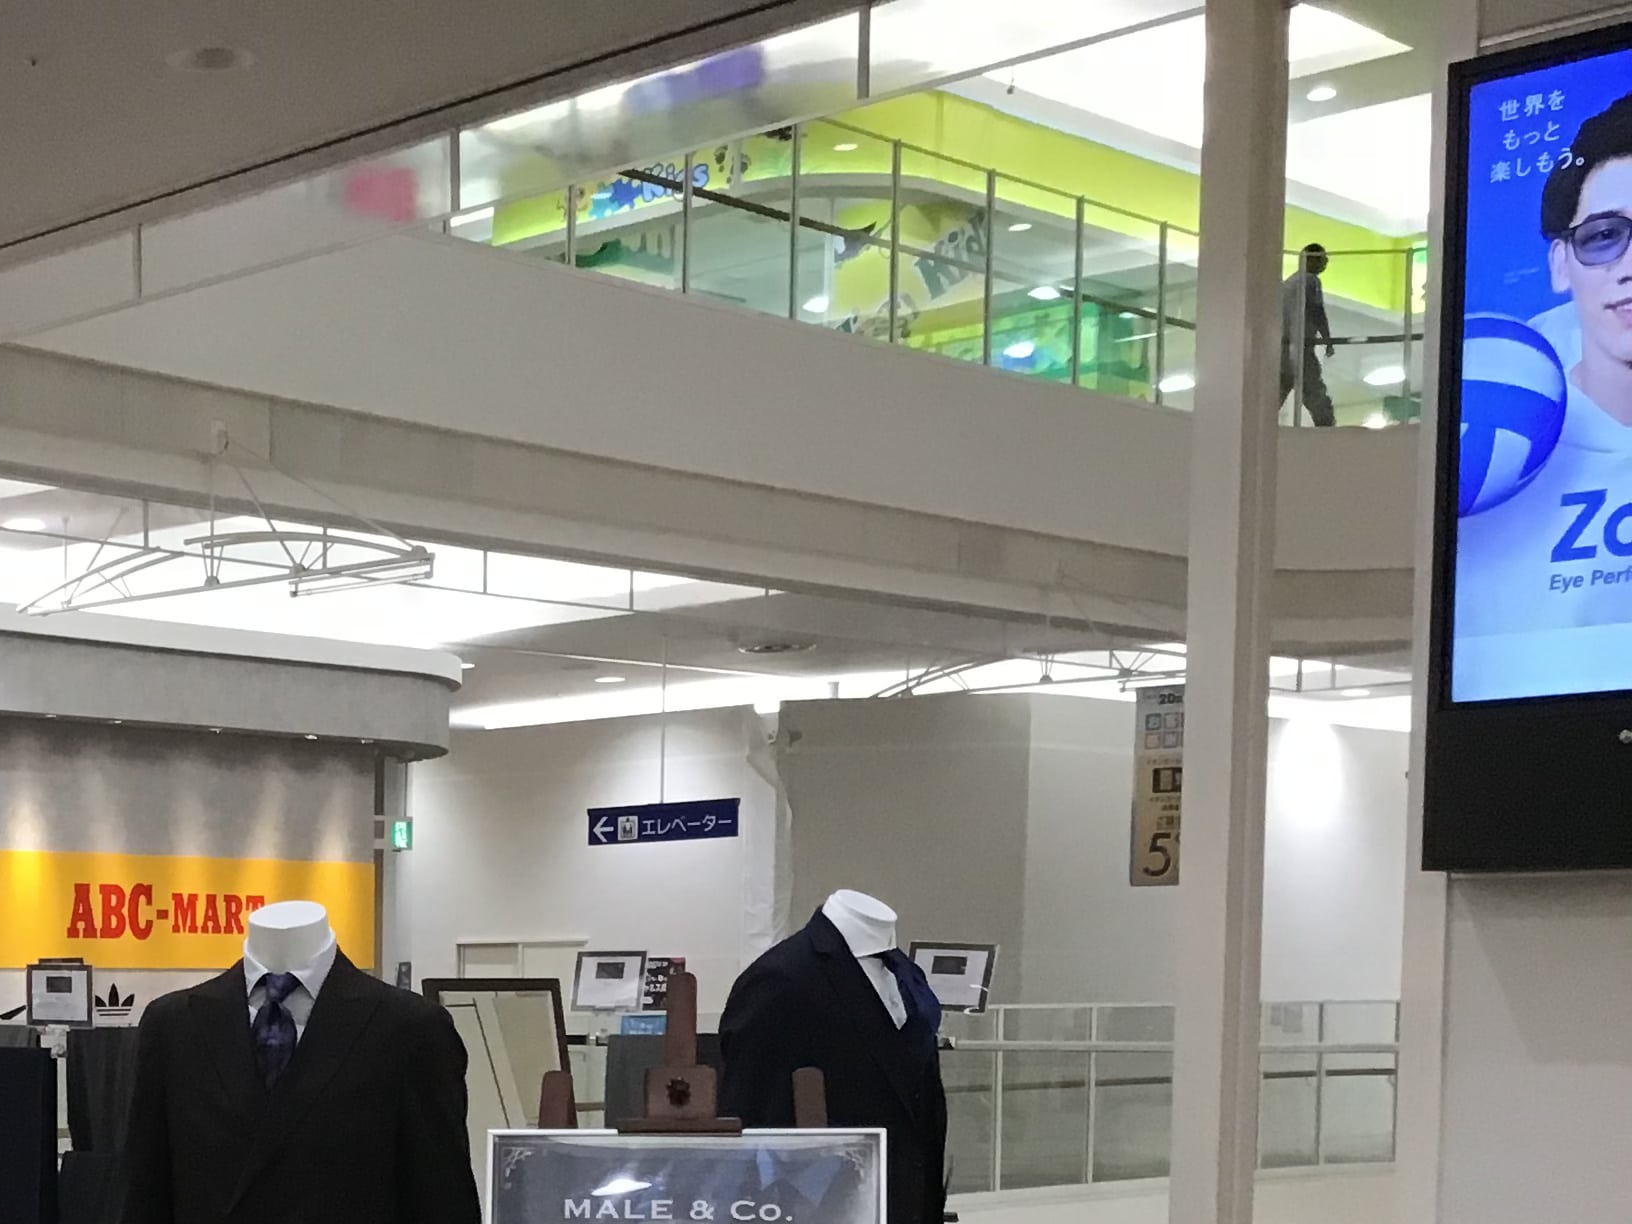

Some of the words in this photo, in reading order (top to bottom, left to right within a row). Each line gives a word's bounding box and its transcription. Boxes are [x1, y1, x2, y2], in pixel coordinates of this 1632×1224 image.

[1499, 90, 1565, 122] 世界を
[1503, 121, 1560, 149] もっと
[1490, 148, 1584, 183] 楽しもう。
[1549, 574, 1584, 593] Eye
[642, 814, 732, 836] エレベーター
[564, 1199, 673, 1221] MALE
[689, 1200, 714, 1221] &
[730, 1200, 793, 1222] Co.
